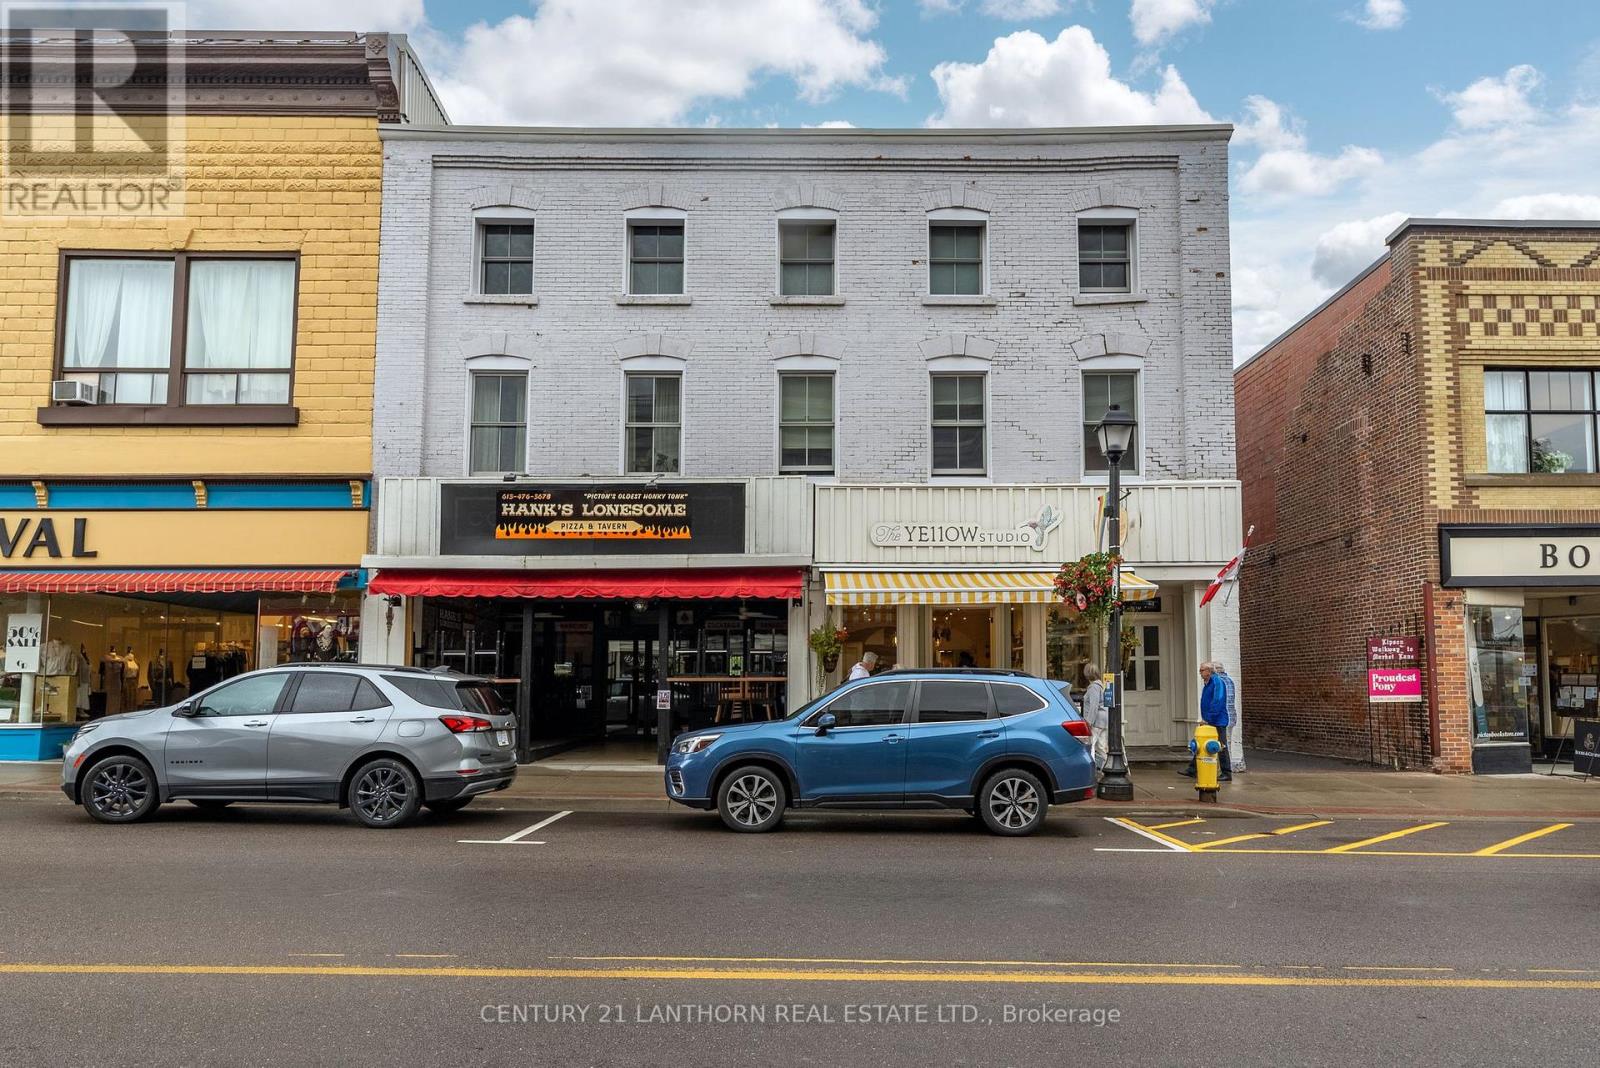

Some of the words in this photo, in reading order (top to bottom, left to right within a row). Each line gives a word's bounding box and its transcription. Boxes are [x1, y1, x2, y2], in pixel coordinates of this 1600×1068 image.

[501, 503, 574, 517] HANK'S
[581, 503, 687, 517] LONESOME
[0, 517, 98, 558] VAL
[875, 525, 901, 543] The
[979, 532, 1031, 543] STUDIO
[1539, 543, 1591, 569] BO
[9, 626, 40, 638] 50%
[1371, 673, 1417, 683] Proudest
[1372, 682, 1397, 693] Pony
